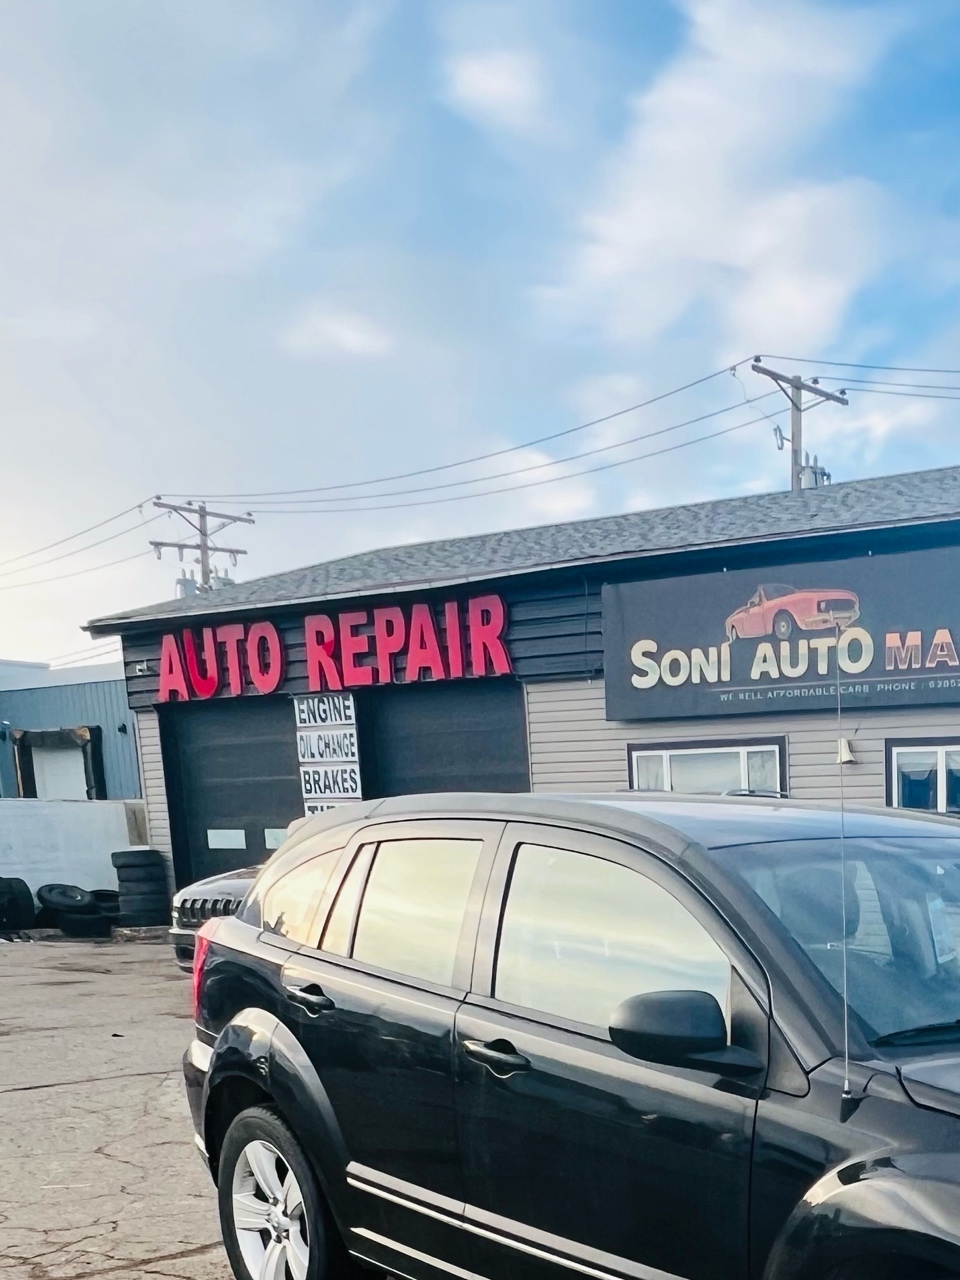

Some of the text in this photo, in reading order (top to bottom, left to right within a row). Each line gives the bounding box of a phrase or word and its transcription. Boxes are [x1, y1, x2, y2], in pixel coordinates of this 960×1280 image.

[158, 594, 511, 702] AUTO REPAIR
[750, 627, 874, 680] AUTO
[299, 696, 353, 724] ENGINE
[299, 732, 356, 759] OIL CHANGE
[302, 768, 358, 795] BRAKES
